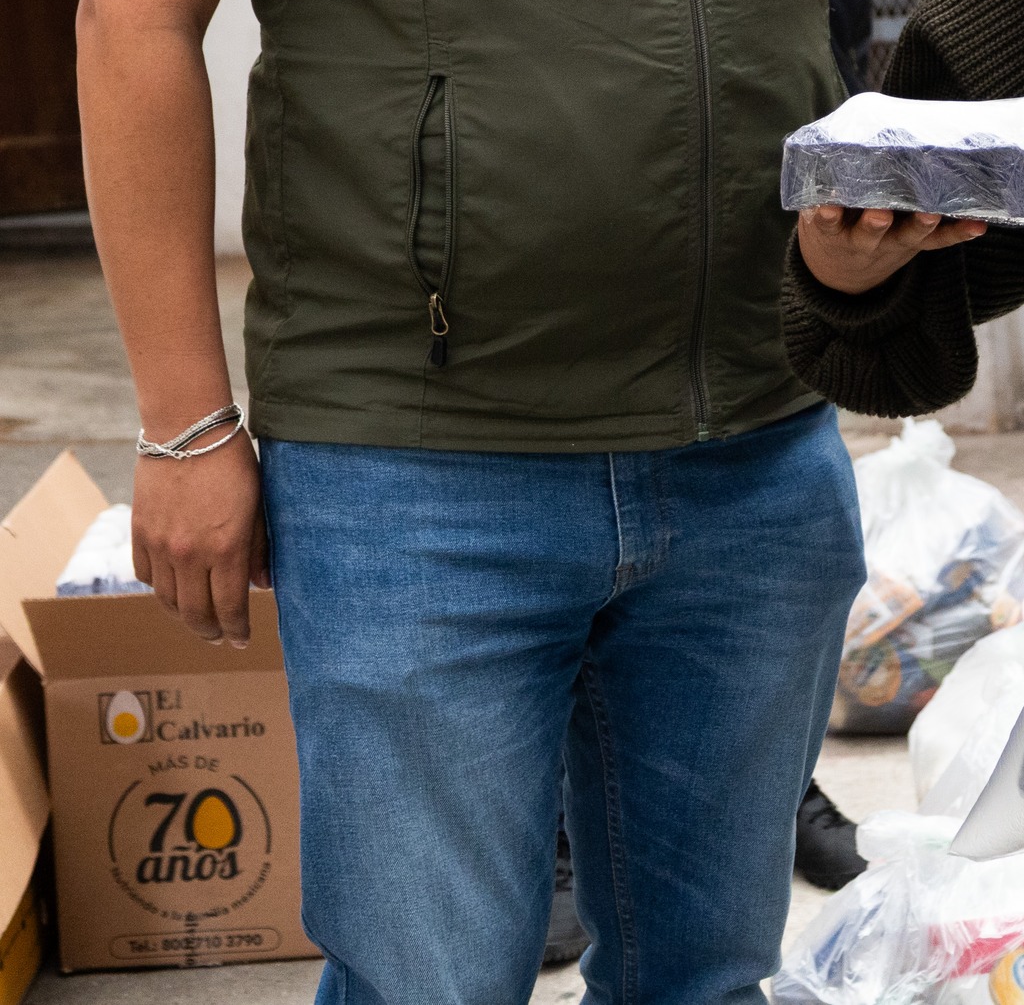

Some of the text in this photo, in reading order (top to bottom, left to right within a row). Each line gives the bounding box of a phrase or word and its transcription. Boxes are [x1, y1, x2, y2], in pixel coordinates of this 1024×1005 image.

[156, 690, 182, 710] El
[156, 716, 265, 742] Calvario
[148, 754, 220, 775] MÁS DE
[144, 788, 242, 854] 70
[136, 847, 241, 884] años
